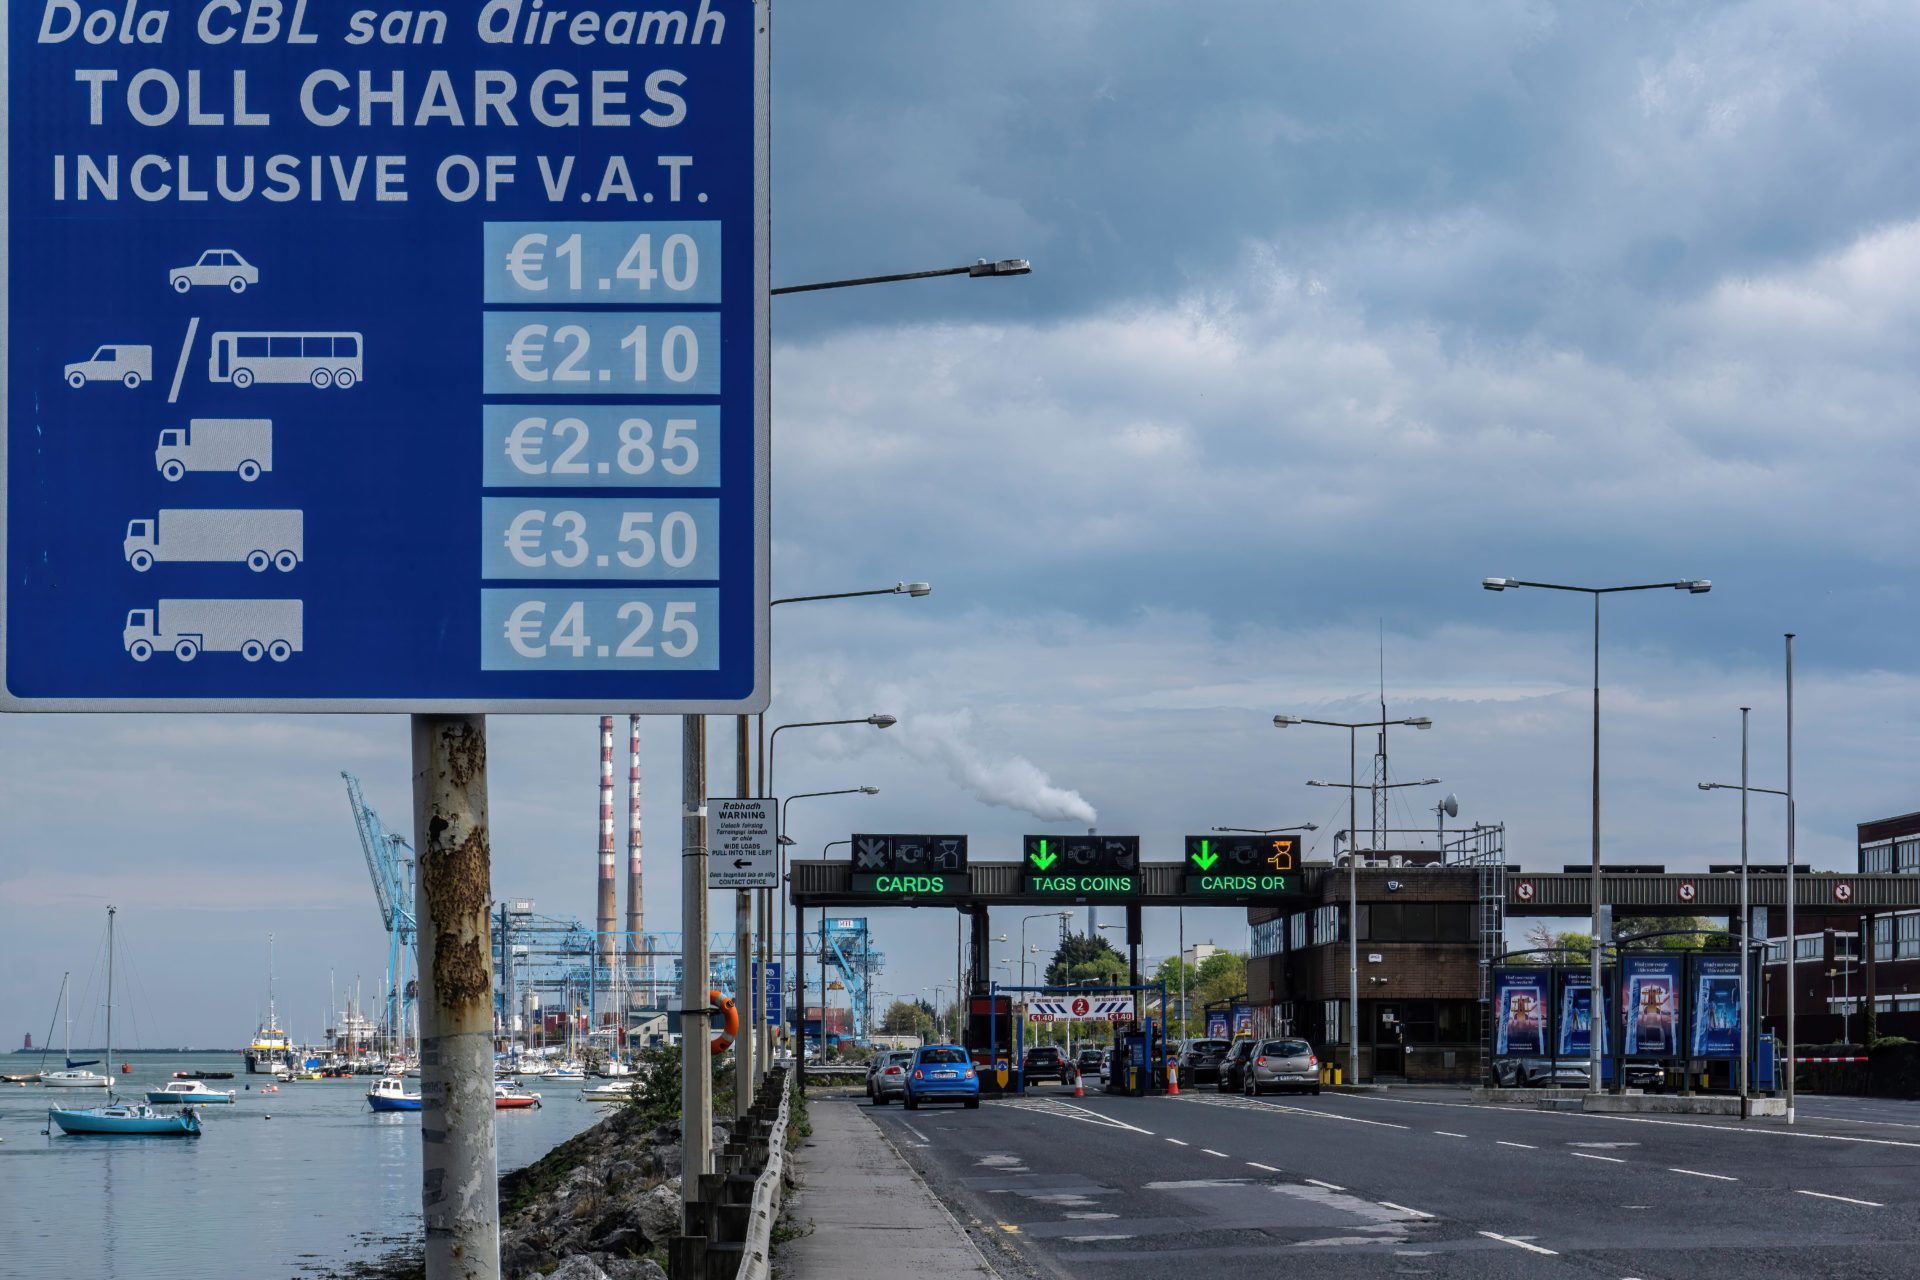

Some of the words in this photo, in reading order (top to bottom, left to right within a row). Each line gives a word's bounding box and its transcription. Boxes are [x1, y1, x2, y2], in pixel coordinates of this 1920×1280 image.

[37, 0, 169, 44] Dola
[197, 0, 319, 44] CBL
[344, 10, 447, 44] san
[74, 68, 270, 127] TOLL
[299, 68, 688, 128] CHARGES
[54, 154, 408, 202] INCLUSIVE
[436, 154, 517, 203] OF
[536, 155, 708, 203] V.A.T.
[506, 234, 698, 291] €1.40
[506, 325, 698, 382] €2.10
[505, 417, 699, 474] €2.85
[504, 510, 698, 567] €3.50
[504, 601, 699, 657] €4.25
[719, 811, 766, 819] WARNING
[723, 802, 761, 810] Rabhadh
[876, 876, 944, 893] CARDS
[1032, 877, 1077, 891] TAGS
[1080, 877, 1131, 891] COINS
[1201, 876, 1257, 890] CARDS
[1261, 876, 1285, 890] OR
[1078, 1002, 1083, 1010] 2
[1110, 1013, 1131, 1021] €1.40
